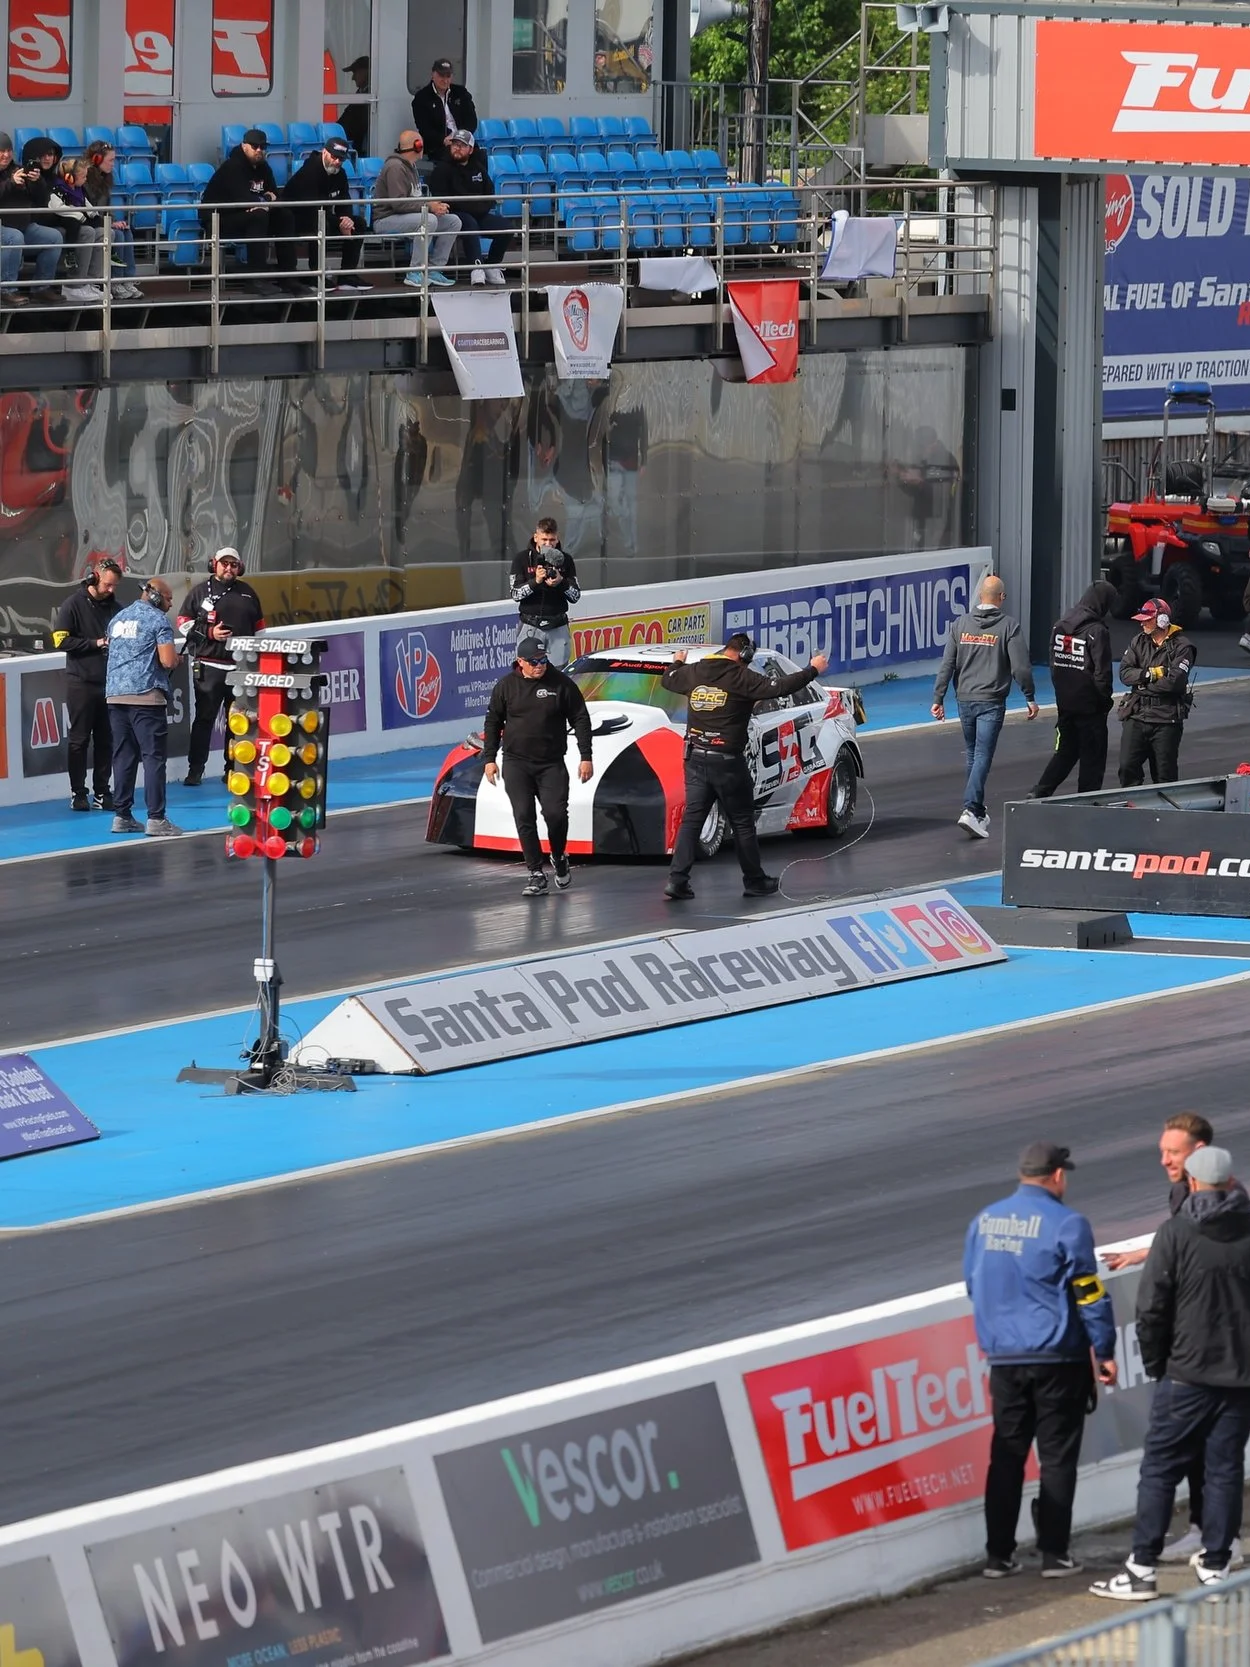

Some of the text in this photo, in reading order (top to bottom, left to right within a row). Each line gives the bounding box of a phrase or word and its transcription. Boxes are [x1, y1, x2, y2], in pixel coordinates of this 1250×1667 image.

[1136, 176, 1236, 240] SOLD
[1125, 282, 1166, 310] FUEL
[1171, 281, 1195, 309] OF
[753, 319, 796, 338] elTech
[1102, 364, 1143, 383] EPARED
[1146, 363, 1174, 380] WITH
[1178, 362, 1193, 379] VP
[1196, 358, 1248, 378] TRACTION
[451, 623, 519, 652] Additives & Coolant
[668, 614, 705, 634] CAR PARTS
[230, 638, 307, 653] PRE-STAGED
[396, 631, 428, 717] VP
[456, 652, 466, 674] for
[468, 649, 488, 673] Track
[490, 648, 496, 669] &
[244, 673, 295, 687] STAGED
[417, 675, 441, 708] Racing
[690, 691, 726, 704] SPRC
[384, 934, 859, 1054] Santa Pod Raceway
[979, 1212, 1042, 1238] Gumball
[986, 1234, 1023, 1256] Racing
[770, 1342, 990, 1467] FuelTech
[852, 1463, 975, 1515] WWW.FUELTECH.NET
[133, 1503, 395, 1653] NEO WTR
